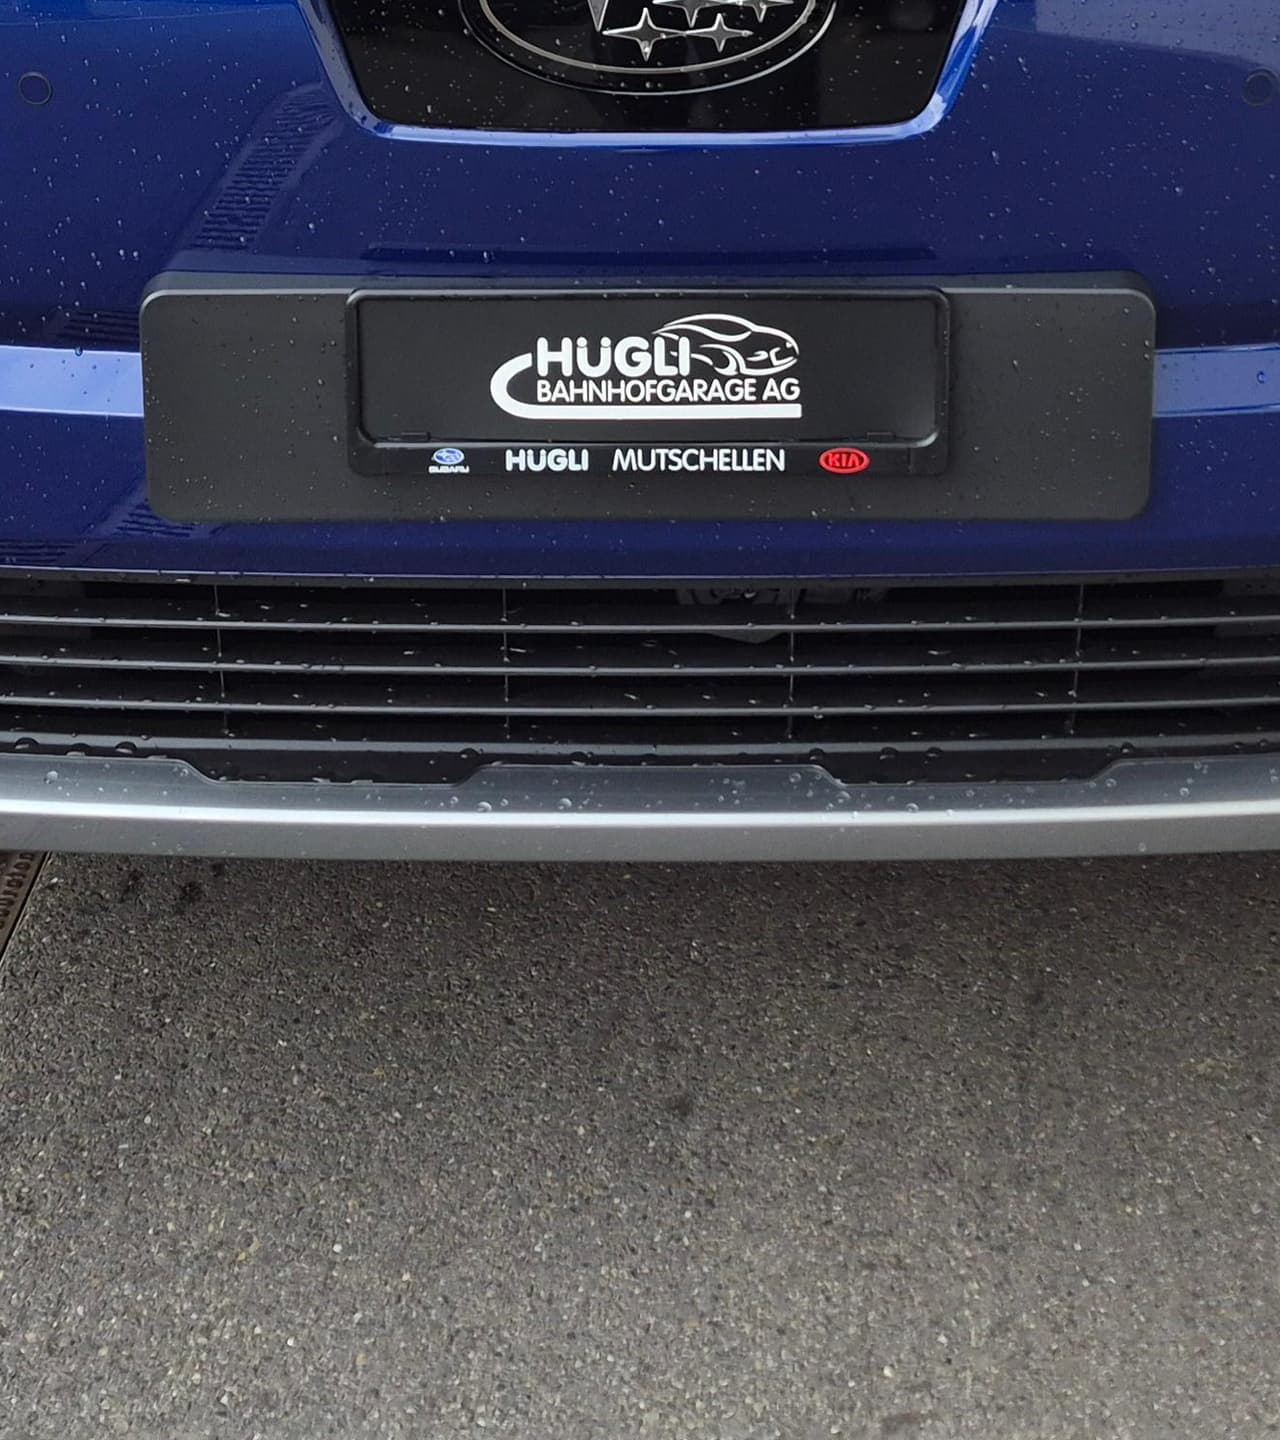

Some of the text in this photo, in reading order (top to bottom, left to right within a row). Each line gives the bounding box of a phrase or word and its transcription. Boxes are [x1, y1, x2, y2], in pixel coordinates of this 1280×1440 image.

[536, 335, 691, 378] HÜGLI
[537, 377, 801, 404] BAHNHOFGARAGE AG
[505, 447, 786, 472] HÜGLI MUTSCHELLEN
